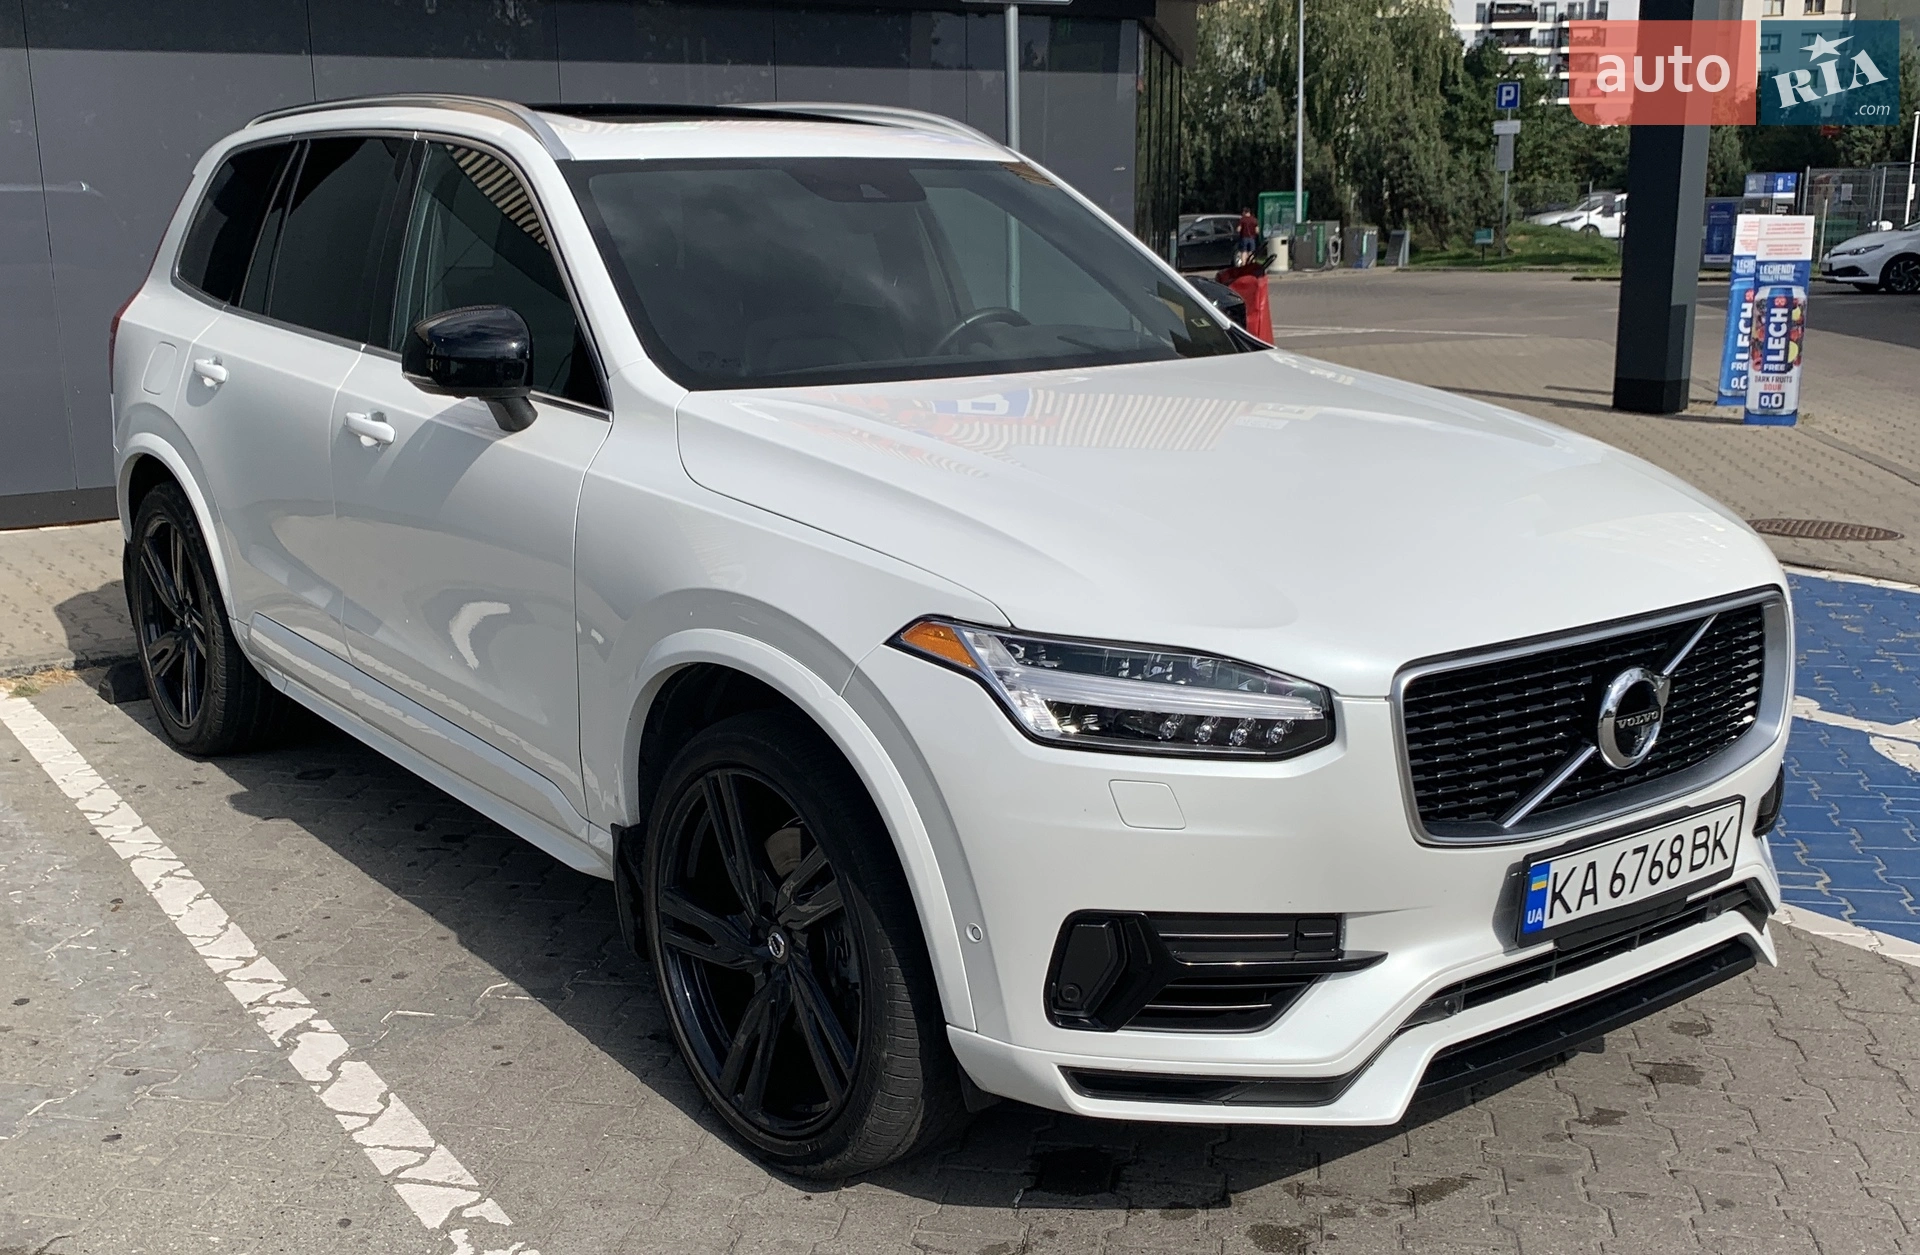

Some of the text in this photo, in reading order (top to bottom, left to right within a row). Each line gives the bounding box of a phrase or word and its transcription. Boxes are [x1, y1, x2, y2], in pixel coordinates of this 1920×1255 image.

[1501, 85, 1515, 106] P
[1766, 308, 1788, 362] LECH
[1731, 361, 1748, 371] FRE
[1763, 363, 1786, 371] FREE
[1754, 375, 1793, 383] DARK FRUITS
[1763, 383, 1782, 391] SOUR
[1760, 393, 1783, 408] 0,0
[1615, 710, 1659, 729] VOLVO
[1548, 815, 1735, 920] KA 6768 BK
[1526, 907, 1543, 925] UA
